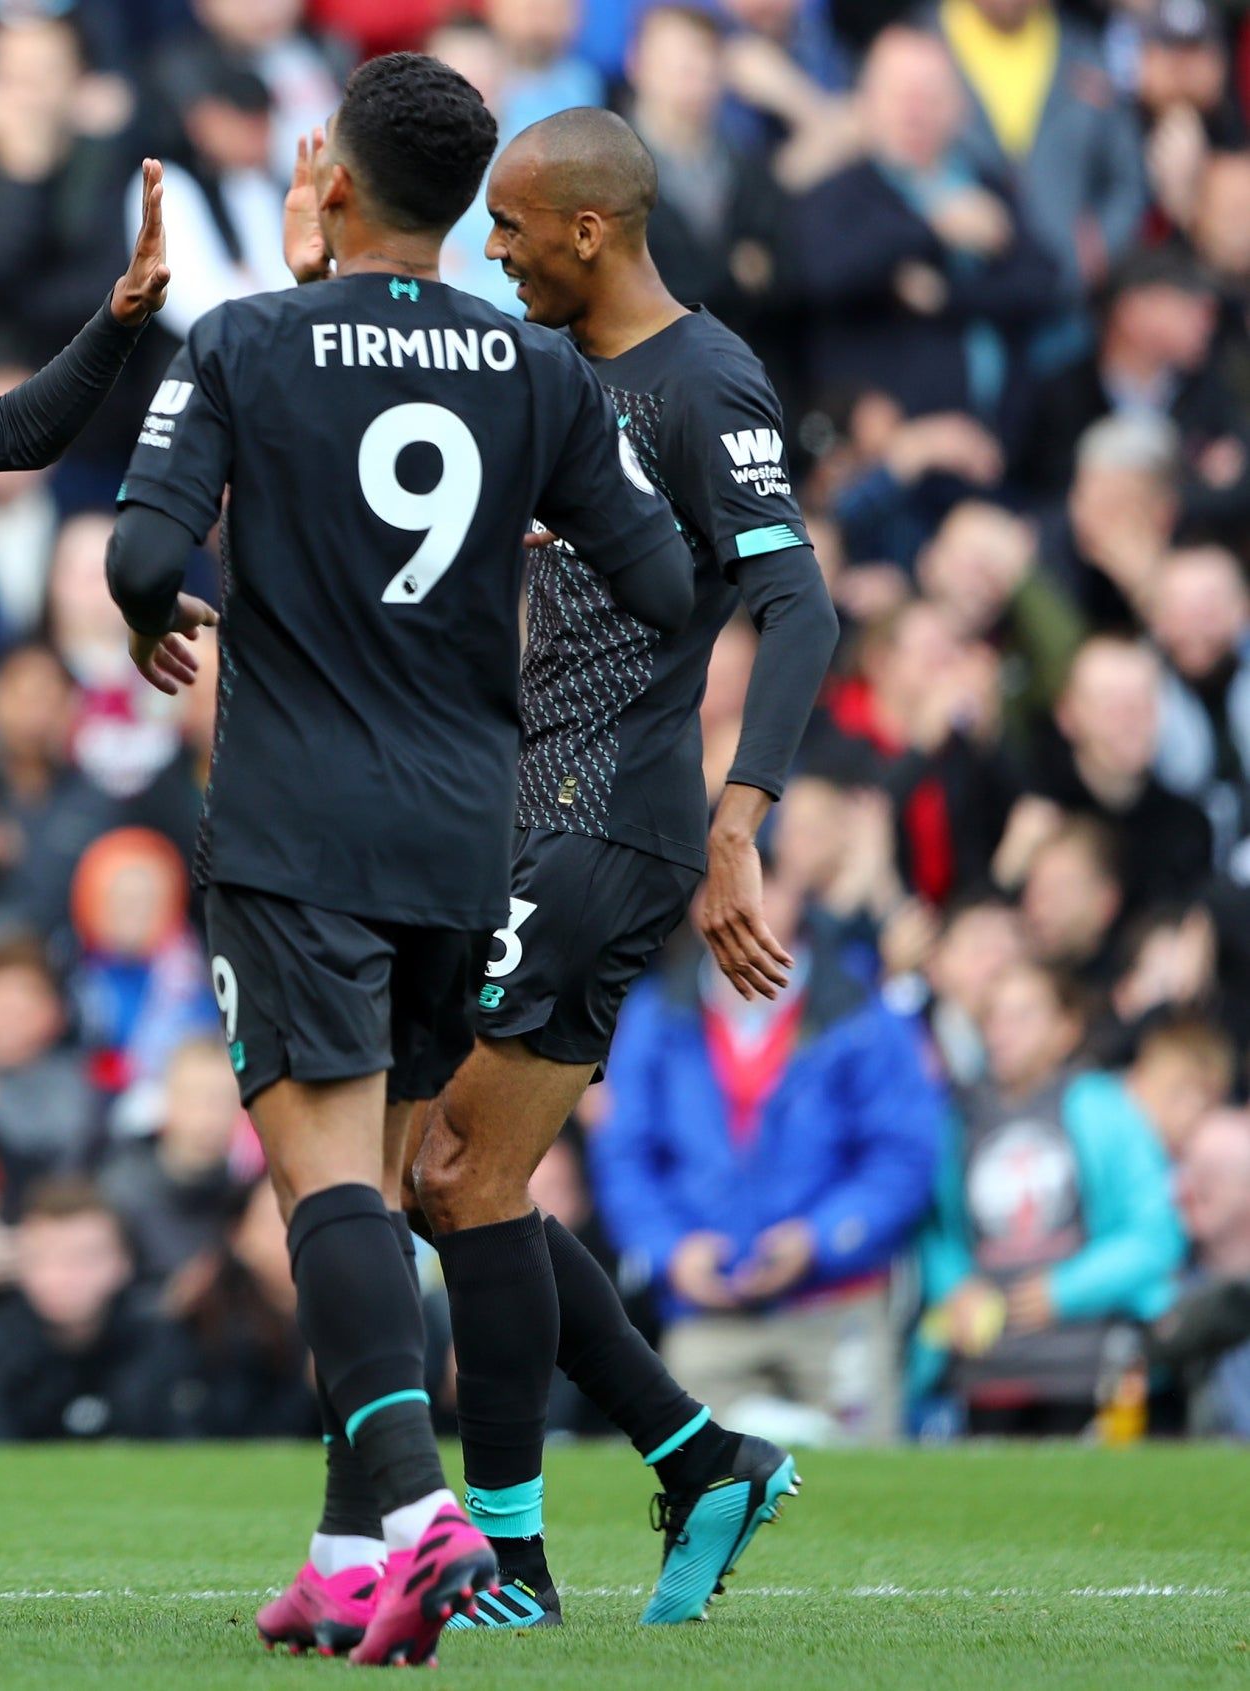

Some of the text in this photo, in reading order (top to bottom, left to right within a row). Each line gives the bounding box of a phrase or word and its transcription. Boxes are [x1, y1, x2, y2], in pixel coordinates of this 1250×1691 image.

[311, 323, 518, 372] FIRMINO
[357, 401, 483, 604] 9
[211, 954, 239, 1044] 9
